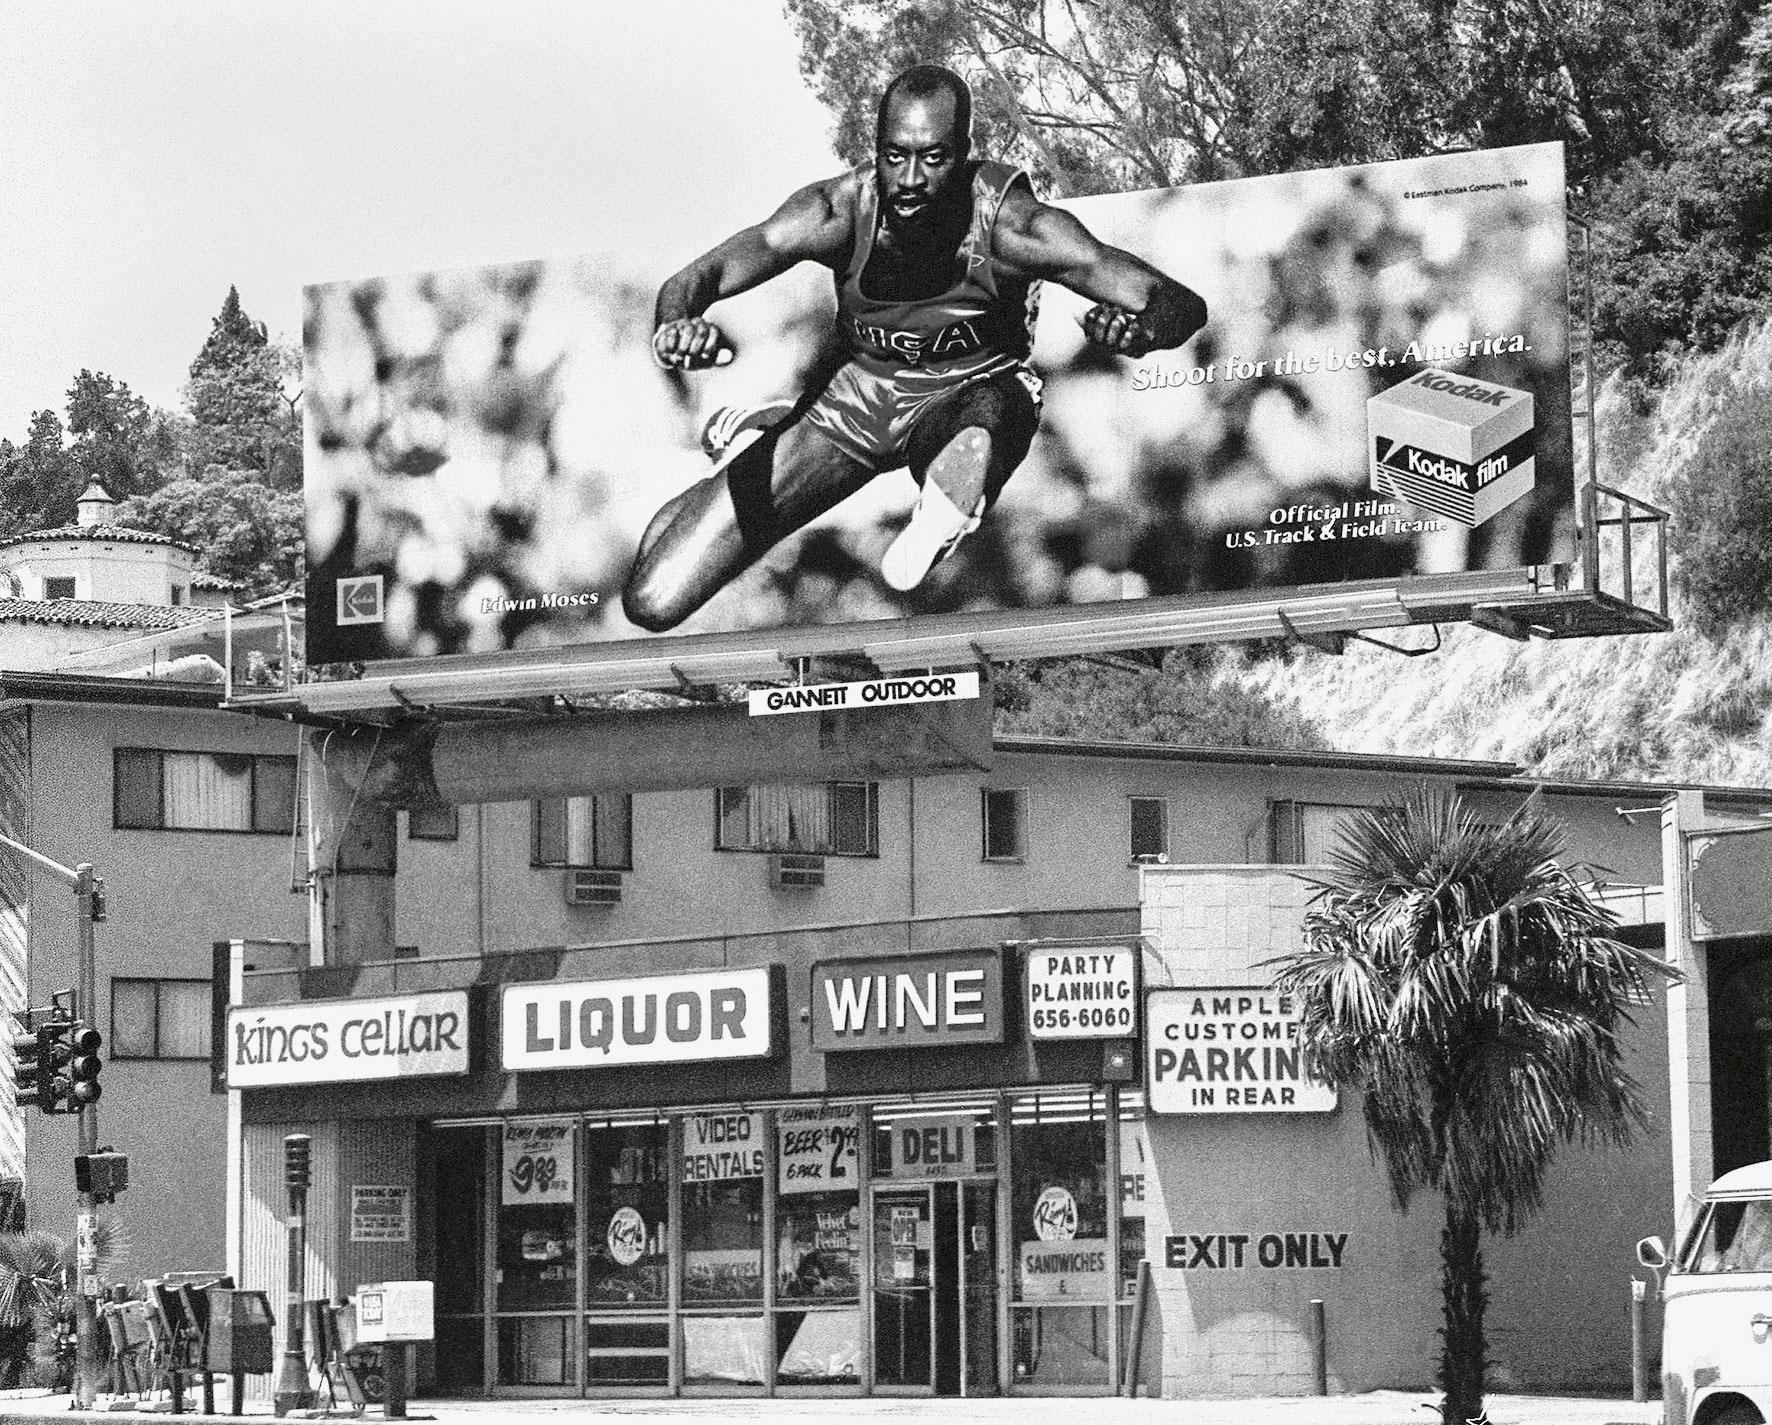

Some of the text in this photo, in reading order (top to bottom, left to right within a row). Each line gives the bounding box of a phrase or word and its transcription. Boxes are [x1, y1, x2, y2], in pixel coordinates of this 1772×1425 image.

[1411, 190, 1443, 199] Eastman
[1444, 186, 1468, 195] Kodak
[1509, 179, 1528, 187] 1984
[1132, 331, 1533, 391] Shoot for the best, America.
[1410, 373, 1511, 406] Kodak
[1408, 449, 1508, 489] Kodak film
[1270, 500, 1400, 524] Official Film.
[1226, 518, 1447, 548] U.S. Track & Field Team.
[481, 593, 599, 614] Edwin Moses
[767, 677, 956, 710] GANNETT OUTDOOR
[1047, 955, 1116, 976] PARTY
[824, 969, 985, 1032] WINE
[1031, 980, 1131, 1004] PLANNING
[1191, 996, 1294, 1016] AMPLE
[525, 986, 747, 1055] LIQUOR
[1164, 1022, 1302, 1041] CUSTOME
[1155, 1047, 1326, 1082] PARKIN
[1192, 1087, 1296, 1106] IN REAR
[695, 1115, 750, 1144] VIDEO
[783, 1128, 823, 1156] BEER
[902, 1126, 964, 1164] DELI
[683, 1149, 764, 1180] RENTALS
[1026, 1252, 1105, 1274] SANDWICHES
[1165, 1233, 1349, 1269] EXIT ONLY
